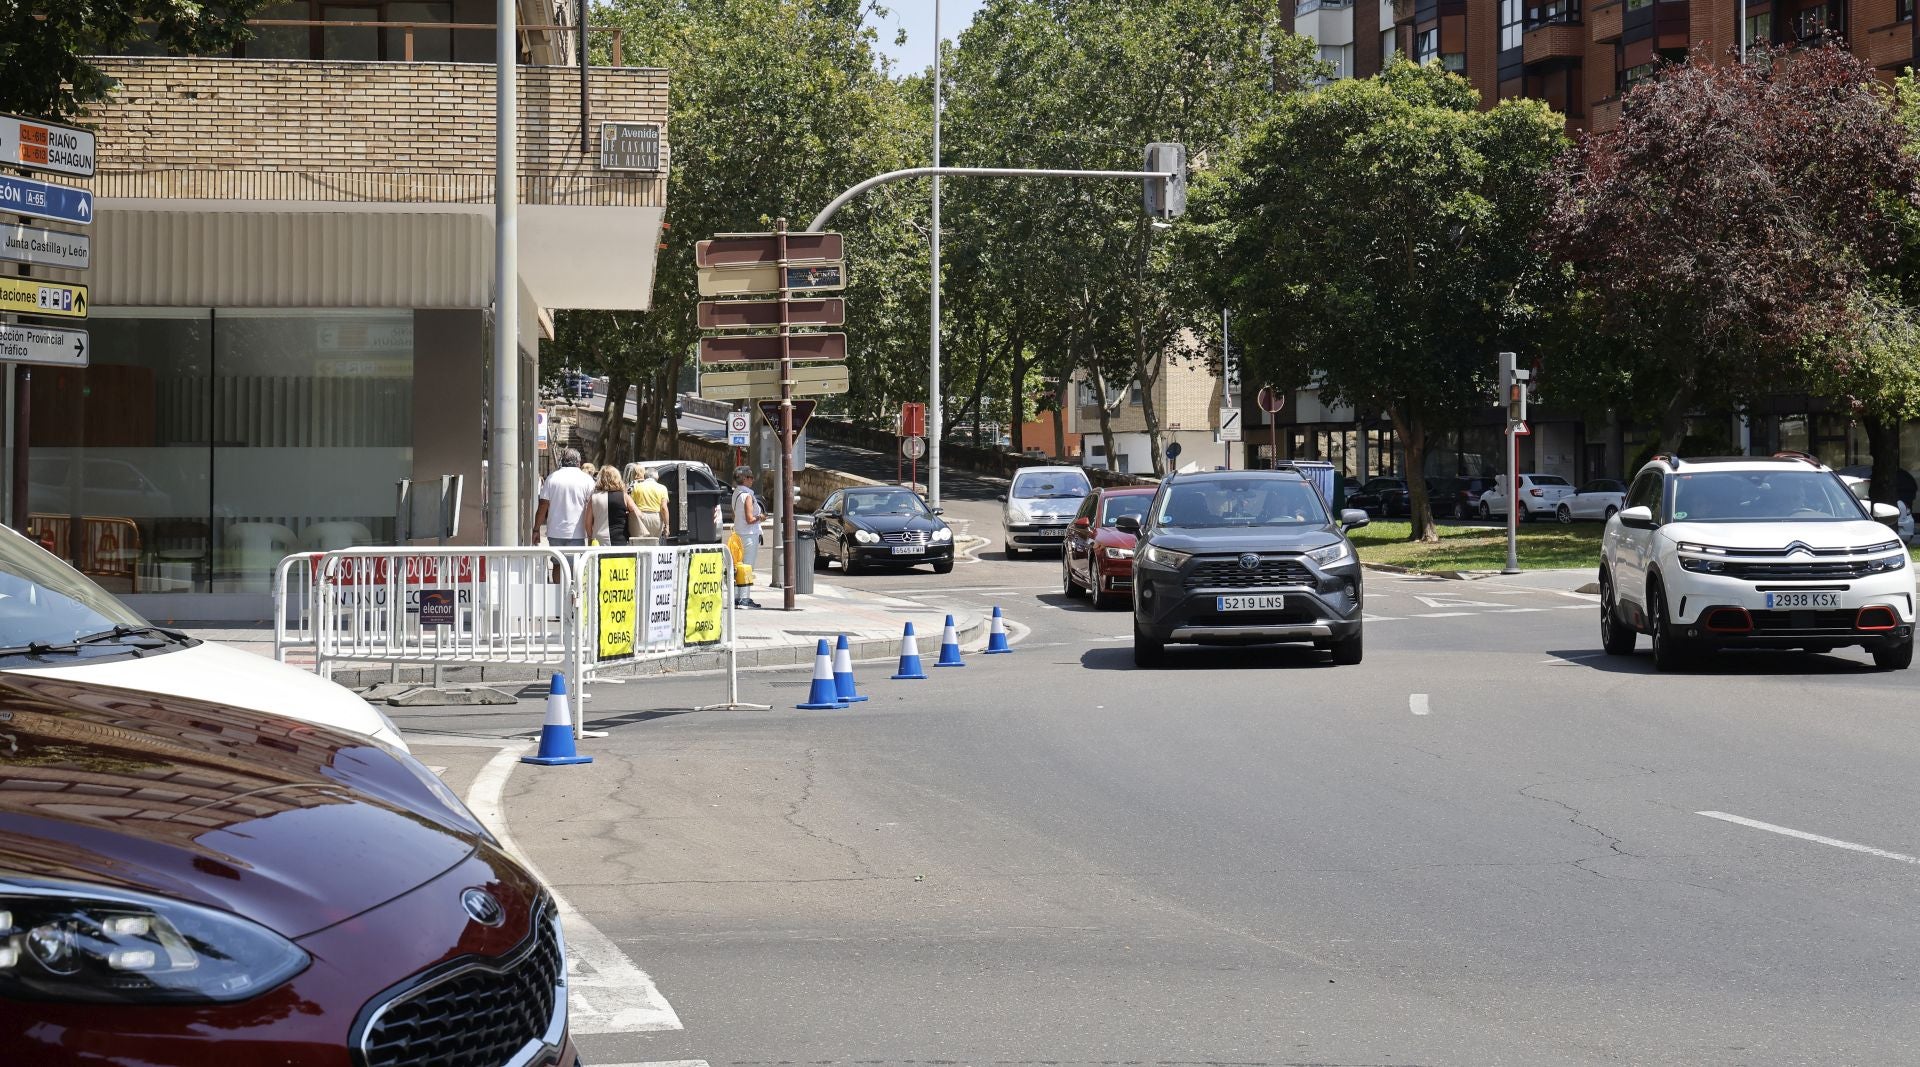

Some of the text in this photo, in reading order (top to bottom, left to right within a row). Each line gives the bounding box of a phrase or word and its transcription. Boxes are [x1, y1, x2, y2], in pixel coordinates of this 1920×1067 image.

[621, 127, 658, 139] Avenida
[49, 132, 77, 150] RIAÑO
[604, 140, 658, 154] DE CASADO
[48, 149, 92, 169] SAHAGUN
[603, 153, 658, 167] DEL ALISAL
[27, 192, 44, 205] A-65
[5, 235, 88, 258] Junta Castilla y León
[27, 331, 64, 346] Provincial
[657, 552, 673, 565] CALLE
[609, 568, 629, 582] CALLE
[699, 562, 716, 575] CALLE
[652, 569, 673, 582] CORTADA
[655, 593, 670, 606] CALLE
[1224, 597, 1282, 609] 5219 LNS
[1775, 593, 1837, 607] 2938 KSX
[423, 602, 452, 614] elecnor
[700, 601, 714, 613] POR
[611, 610, 626, 624] POR
[650, 610, 671, 623] CORTADA
[694, 620, 714, 632] OBRAS
[607, 631, 631, 645] OBRAS
